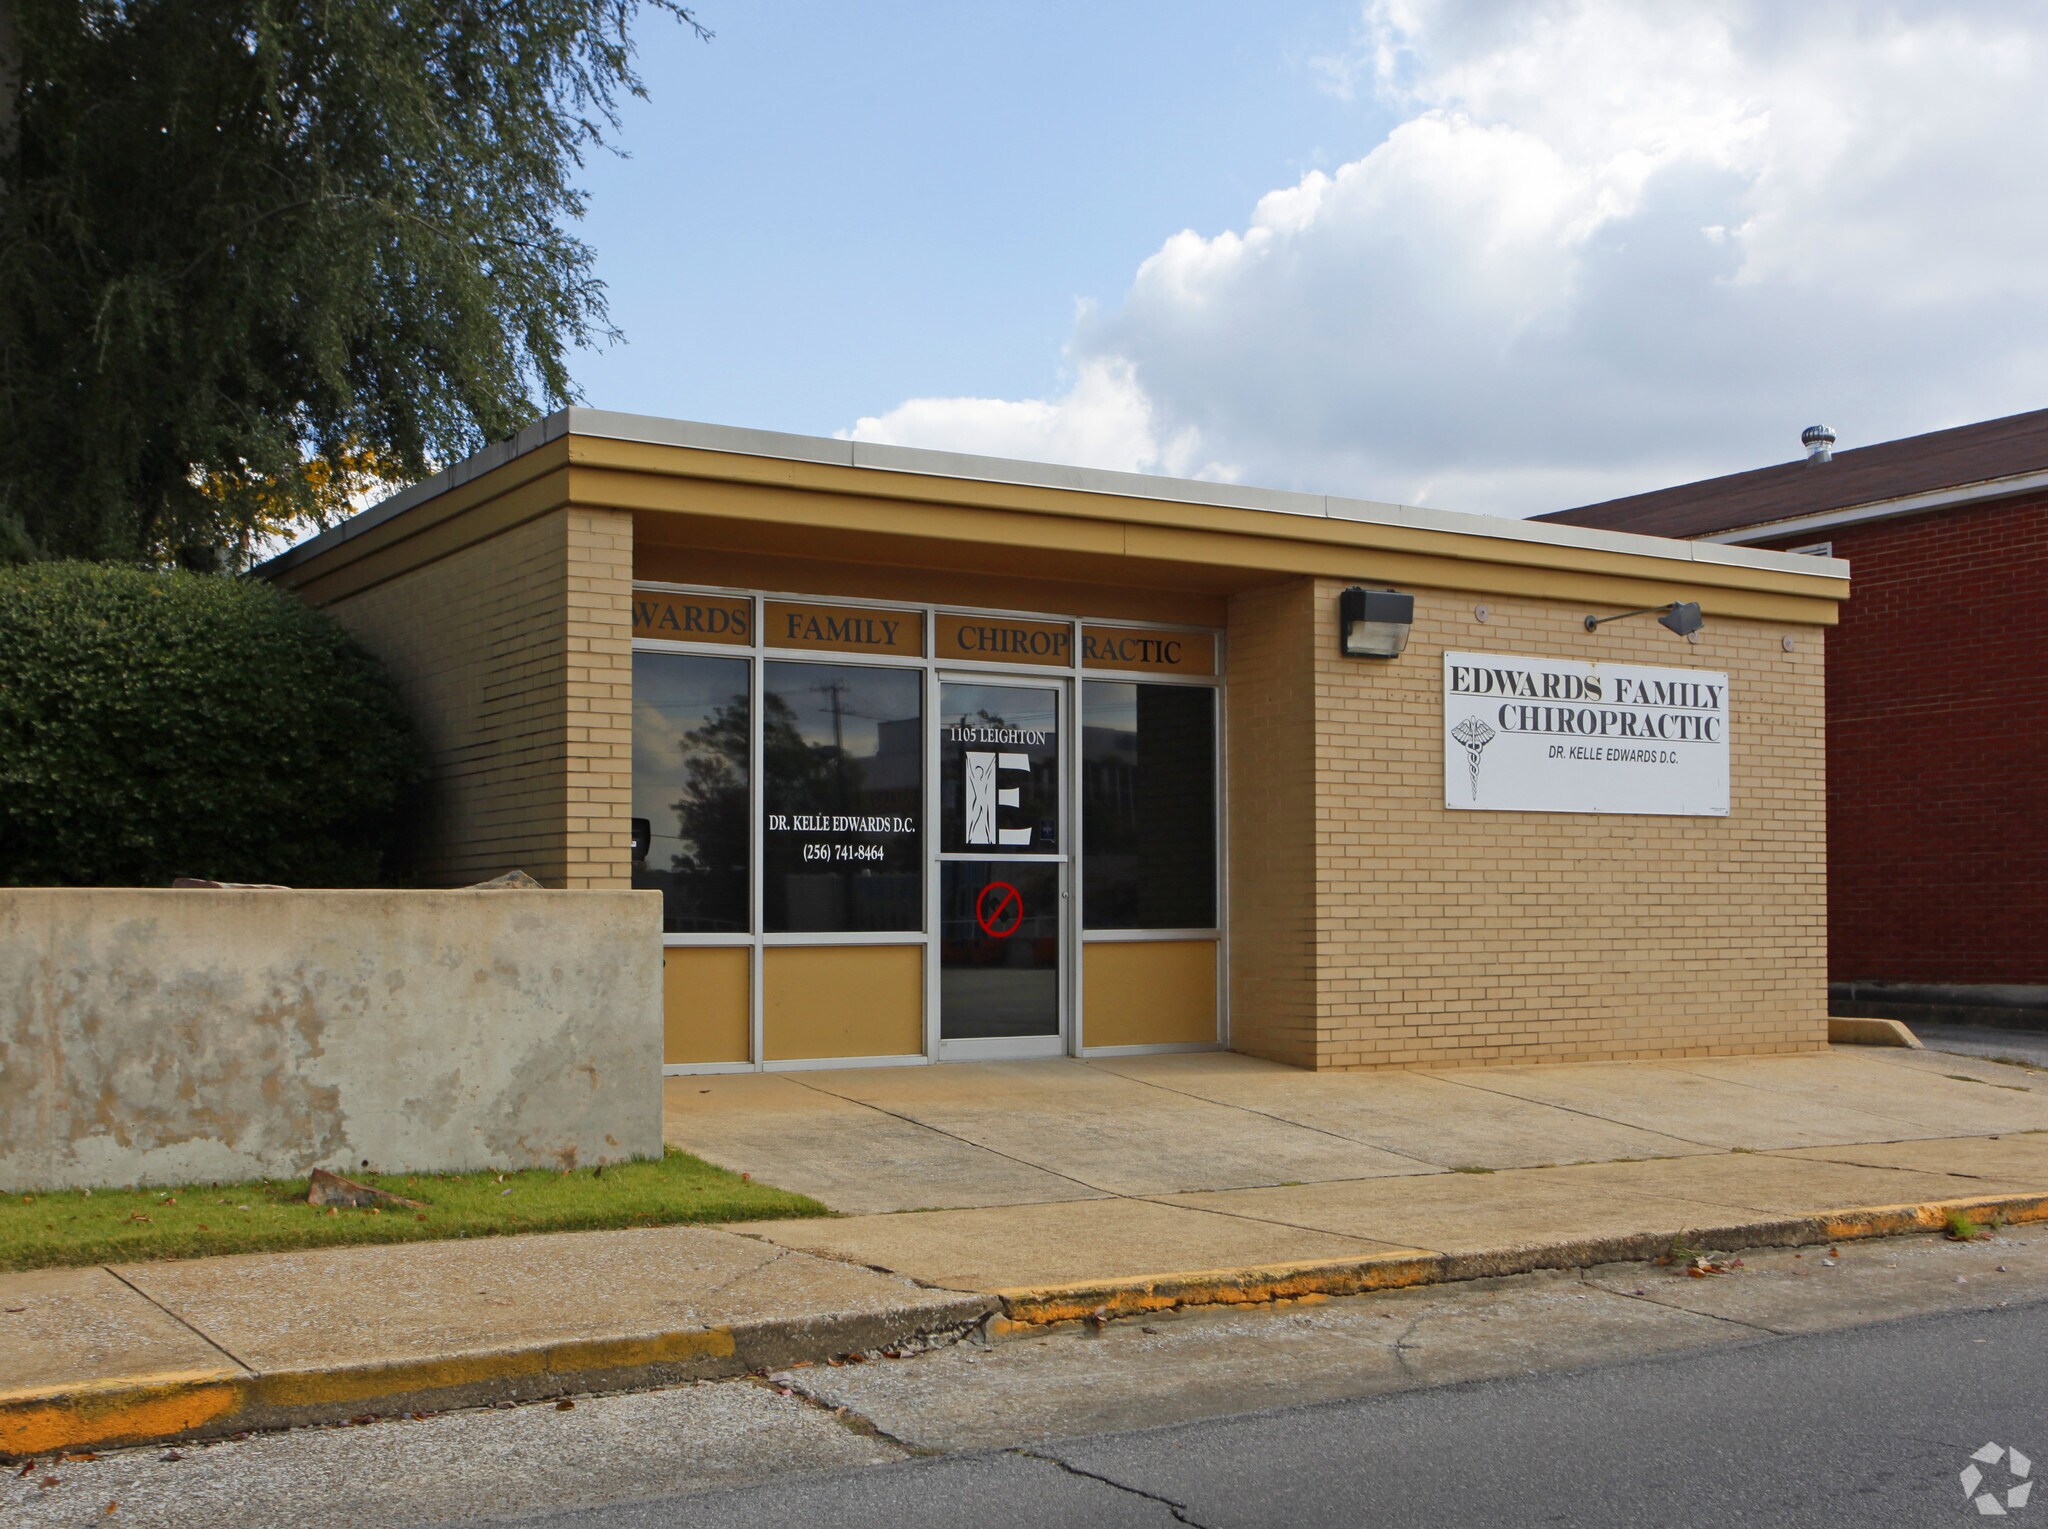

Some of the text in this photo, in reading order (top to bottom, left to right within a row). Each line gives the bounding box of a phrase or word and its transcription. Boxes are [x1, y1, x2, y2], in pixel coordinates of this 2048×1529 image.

[786, 612, 901, 646] FAMILY
[957, 625, 1182, 664] CHIROPRACTIC
[1450, 665, 1724, 708] EDWARDS FAMILY
[1498, 703, 1721, 741] CHIROPRACTIC
[950, 728, 1046, 746] 1105 LEIGHTON
[1548, 745, 1679, 764] DR. KELLE EDWARDS D.C.
[769, 814, 915, 832] DR. KELLE EDWARDS D.C.
[803, 844, 885, 862] (256) 741-8464
